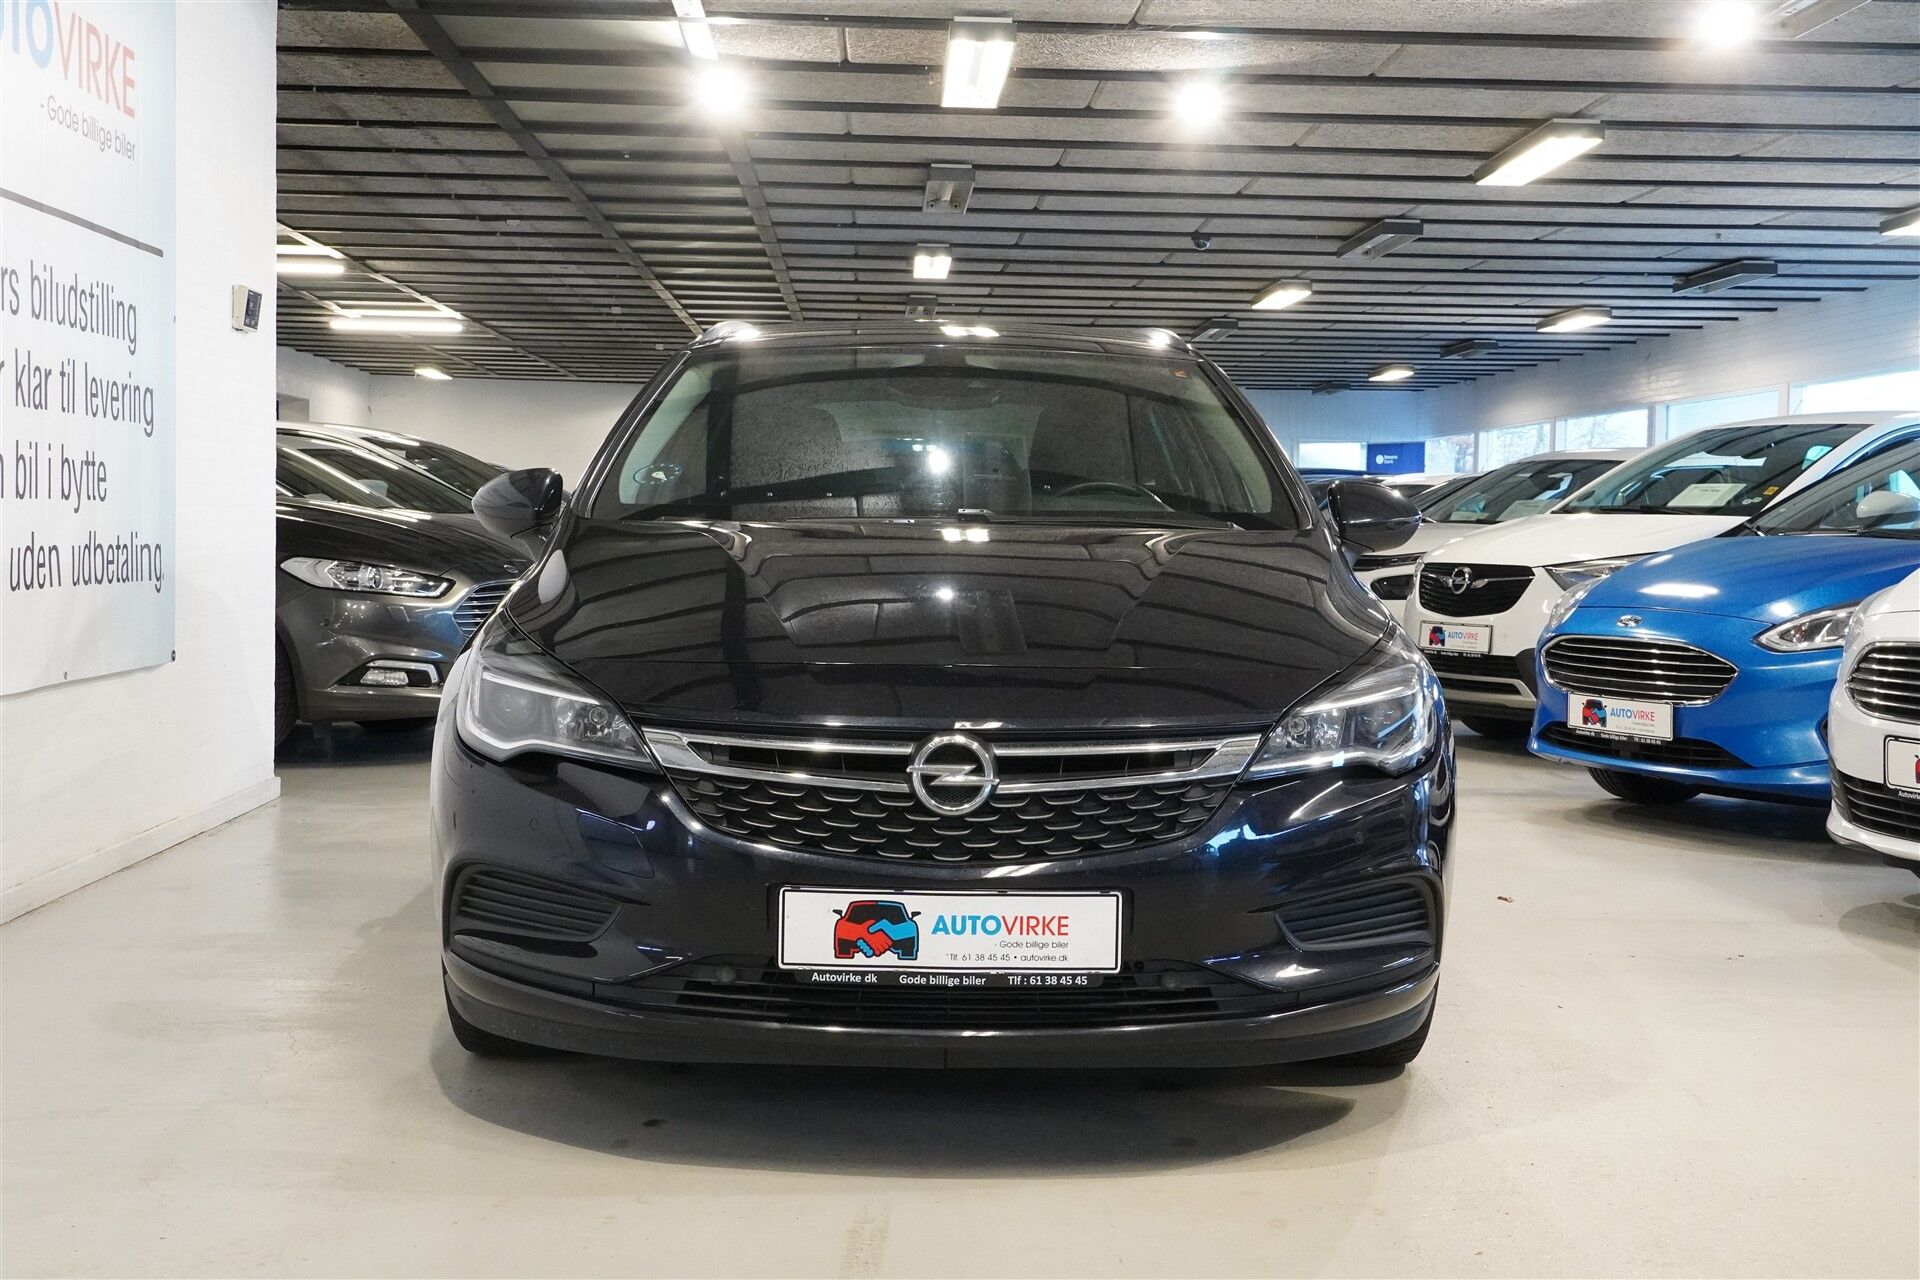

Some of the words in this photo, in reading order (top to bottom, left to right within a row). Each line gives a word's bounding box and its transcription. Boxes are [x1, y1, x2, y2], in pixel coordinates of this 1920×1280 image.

[47, 95, 79, 132] Gode
[82, 110, 112, 152] billige
[114, 133, 136, 161] biler
[30, 259, 137, 356] biludstilling
[15, 347, 53, 411] klar
[59, 358, 75, 414] til
[84, 362, 154, 438] levering
[15, 439, 38, 500] bil
[48, 442, 52, 500] i
[61, 443, 107, 514] bytte
[10, 531, 62, 592] uden
[1609, 707, 1656, 722] AUTOVIRKE
[930, 914, 1070, 936] AUTOVIRKE
[999, 940, 1024, 950] Gode
[1025, 940, 1050, 951] billige
[1051, 940, 1070, 950] biler
[961, 953, 972, 962] 61
[974, 953, 986, 962] 38
[987, 953, 999, 962] 45
[1000, 953, 1011, 962] 45
[1020, 953, 1070, 963] autovirke.dk
[811, 972, 862, 983] Autovirke
[864, 972, 878, 983] dk
[899, 975, 927, 985] Gode
[929, 975, 960, 987] billige
[962, 975, 987, 986] biler
[1007, 975, 1022, 985] Tlf
[1029, 976, 1042, 985] 61
[1044, 976, 1058, 985] 38
[1059, 976, 1073, 985] 45
[1074, 976, 1088, 985] 45
